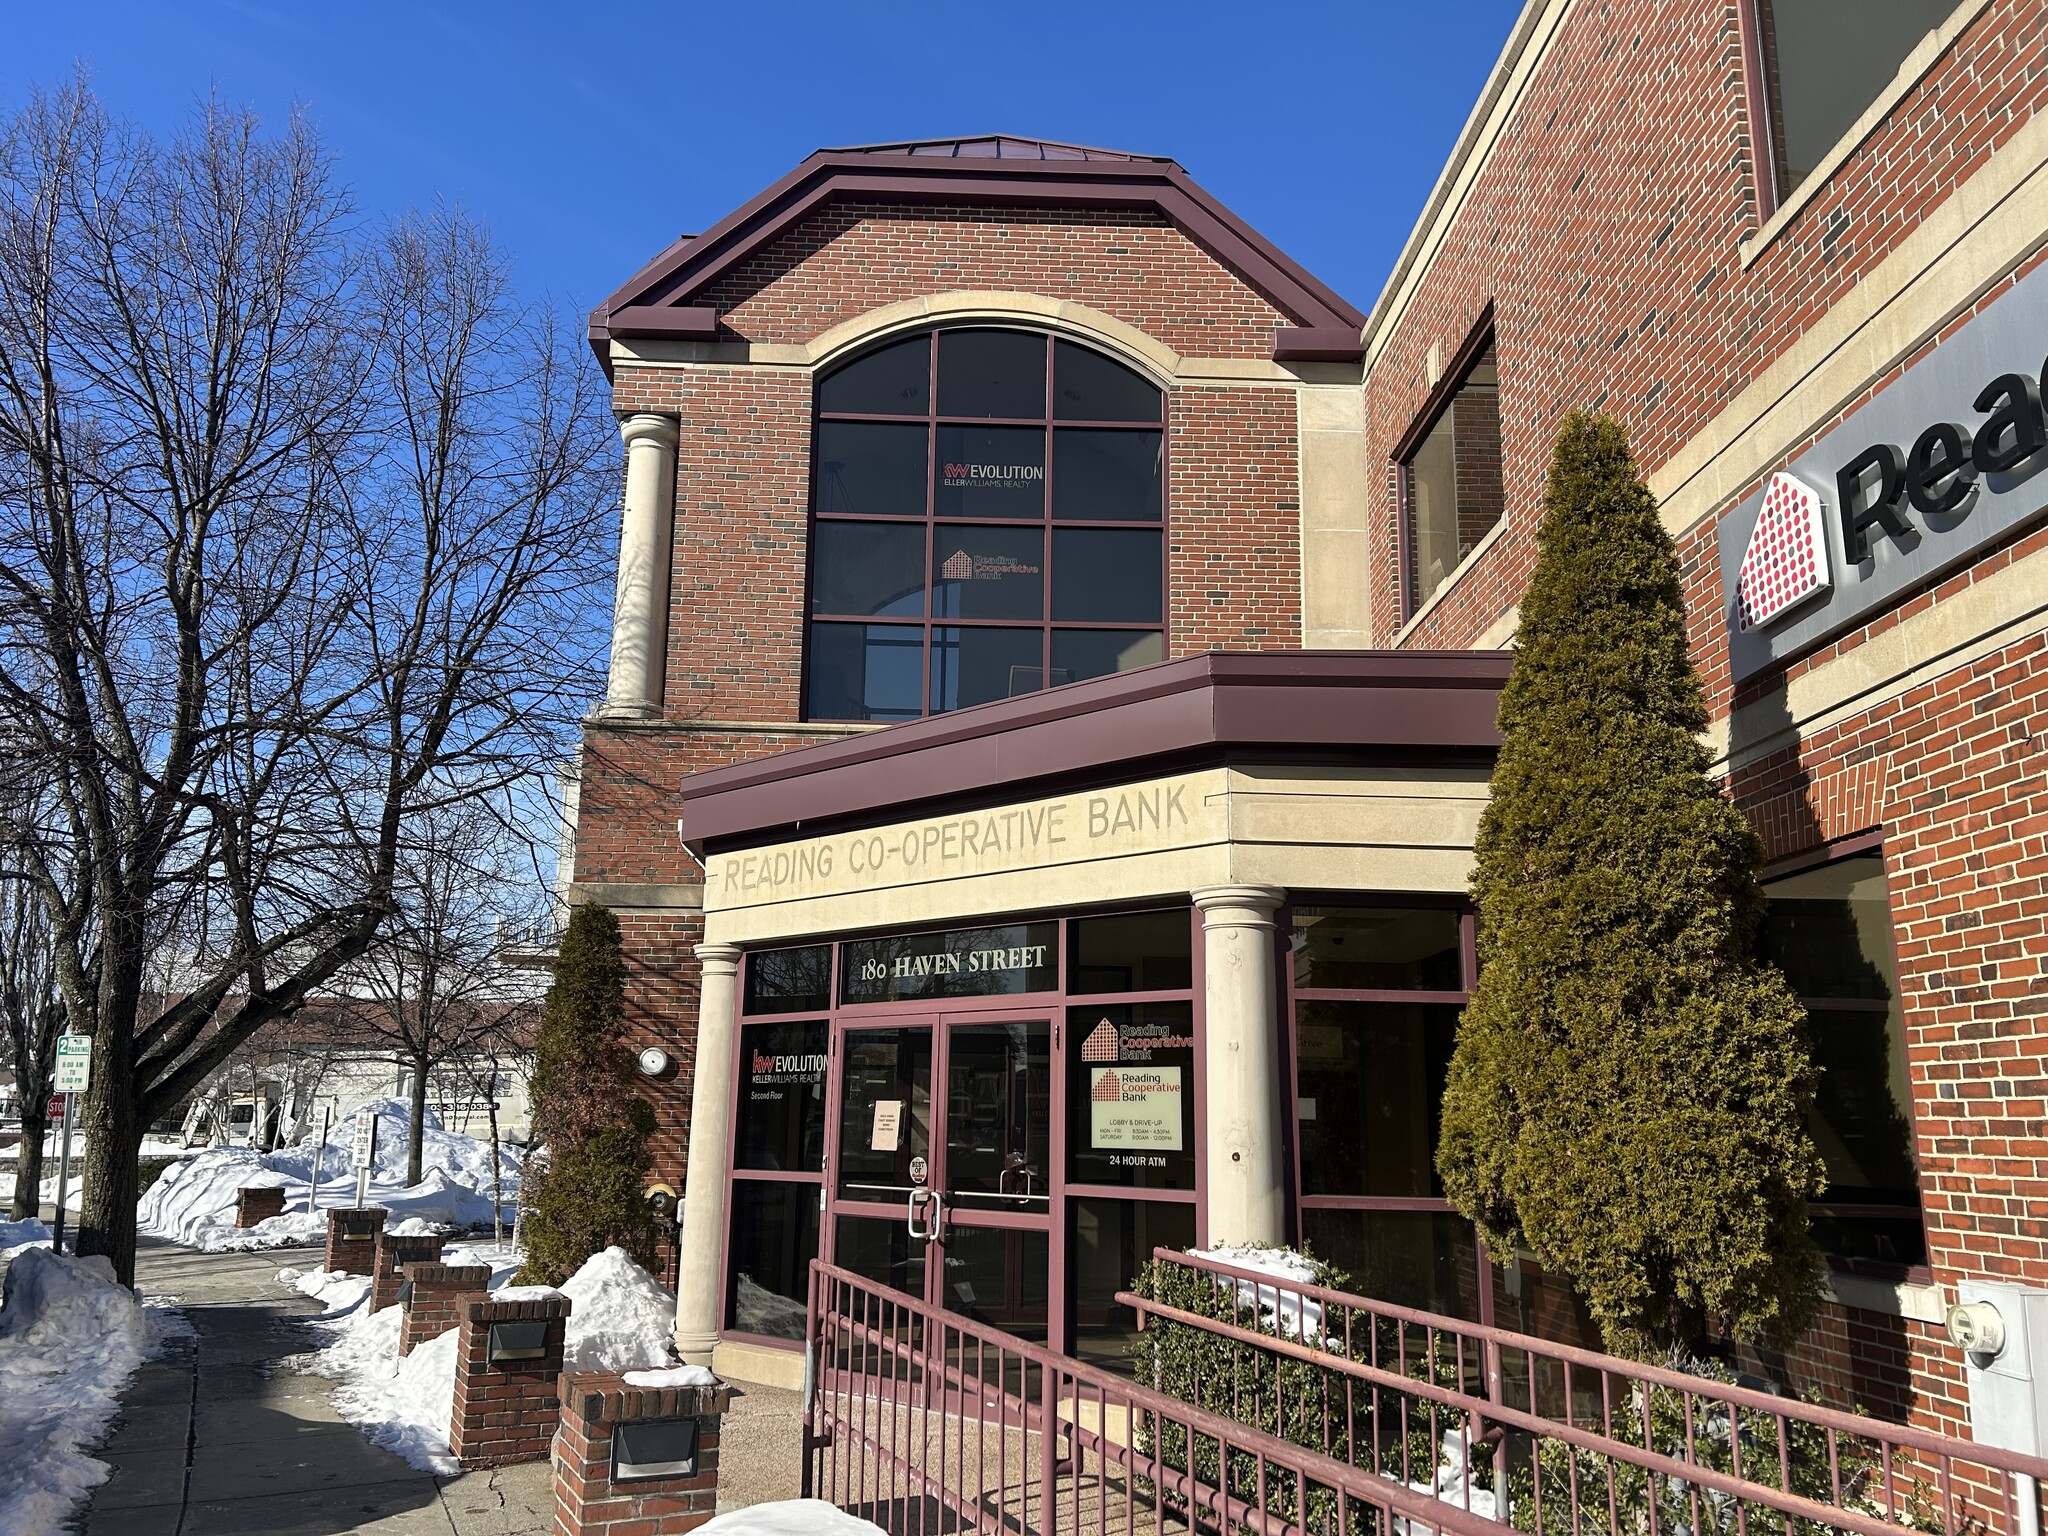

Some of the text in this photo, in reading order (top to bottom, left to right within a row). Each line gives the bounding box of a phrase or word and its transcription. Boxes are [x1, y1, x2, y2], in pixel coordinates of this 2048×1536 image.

[1837, 353, 2048, 565] Rea
[970, 464, 1042, 480] EVOLUTION
[1004, 480, 1031, 488] REALTY
[974, 555, 1018, 566] Reading
[973, 564, 1039, 574] Cooperative
[974, 572, 1002, 580] Bank
[725, 783, 1189, 892] READING CO-OPERATIVE BANK
[861, 945, 1047, 980] 180 HAVEN STREET
[1120, 1024, 1169, 1038] Reading
[60, 1040, 68, 1052] 2
[1119, 1035, 1193, 1050] Cooperative
[1120, 1048, 1152, 1060] Bank
[775, 1054, 828, 1072] EVOLUTION
[1122, 1074, 1161, 1086] Reading
[1122, 1083, 1180, 1094] Cooperative
[751, 1091, 783, 1100] Second Floor
[1122, 1093, 1146, 1102] Bank
[1109, 1155, 1166, 1167] 24 HOUR ATM
